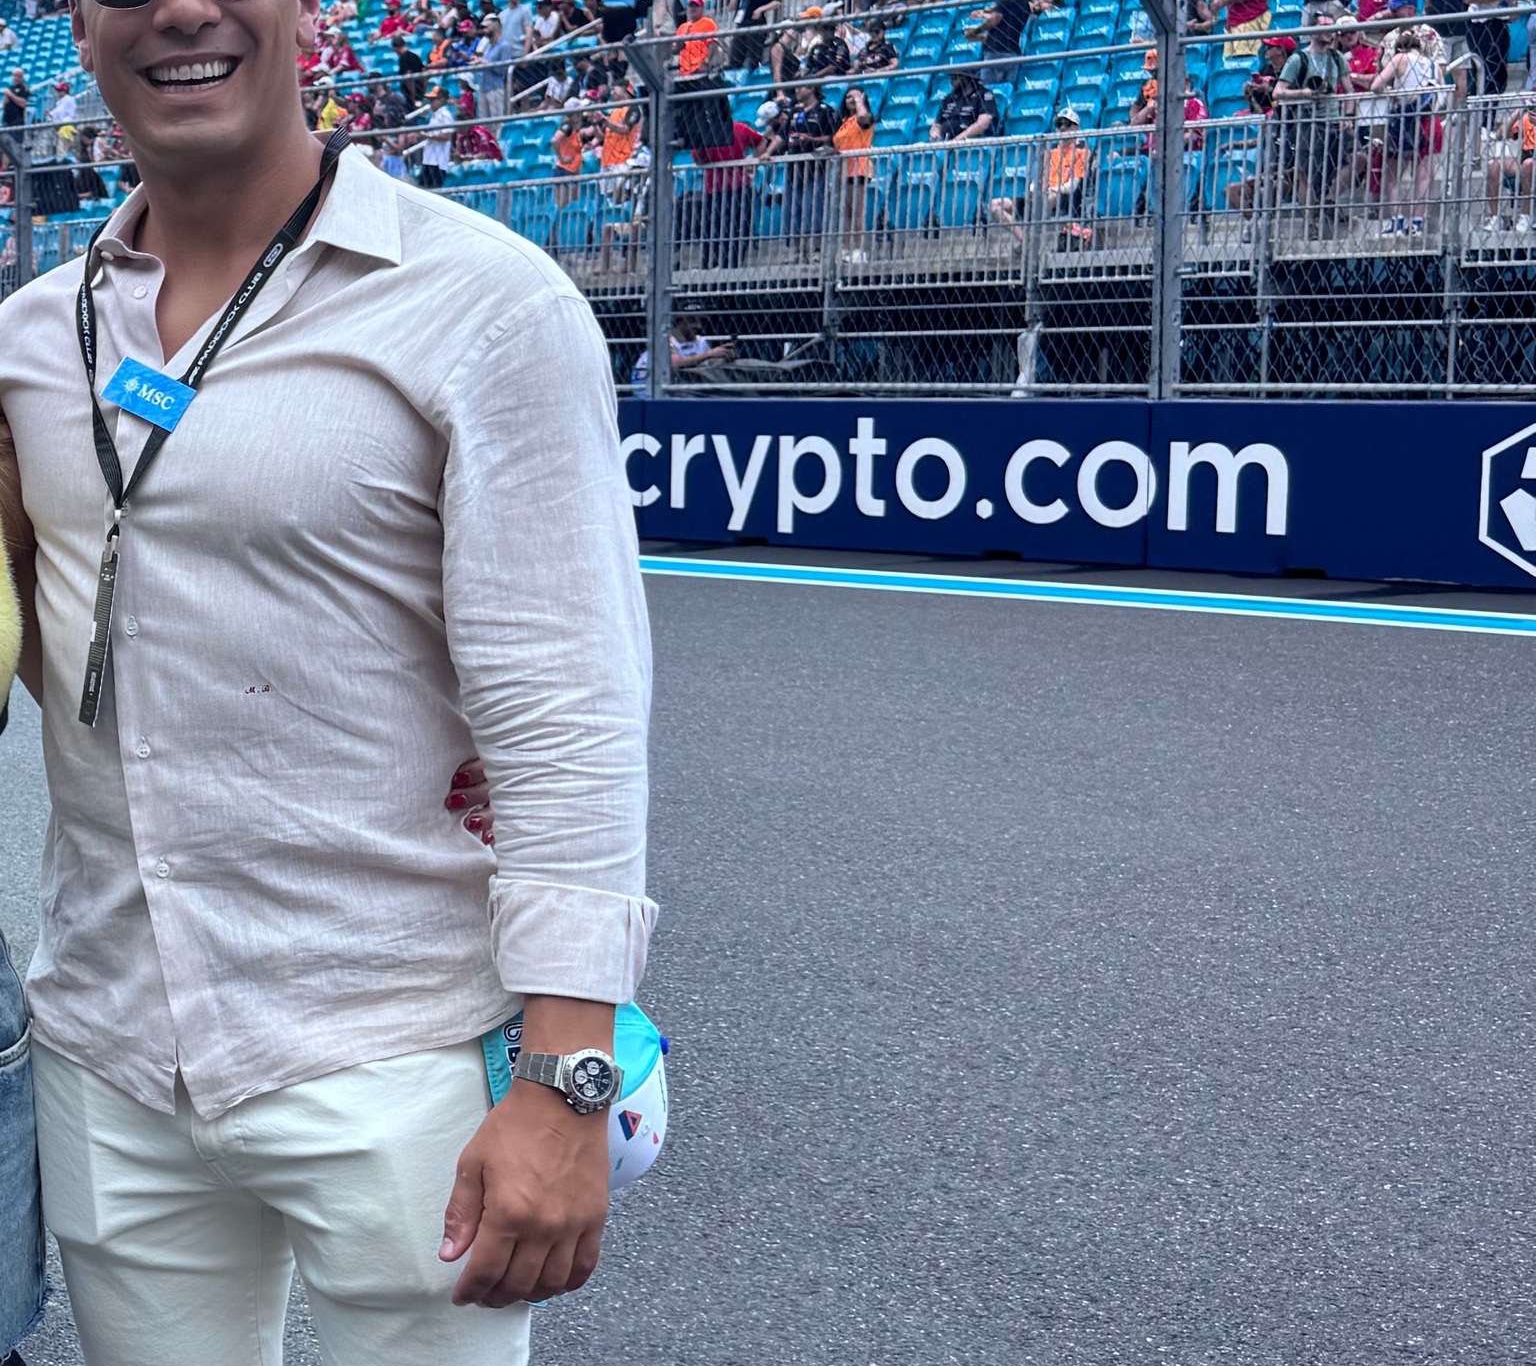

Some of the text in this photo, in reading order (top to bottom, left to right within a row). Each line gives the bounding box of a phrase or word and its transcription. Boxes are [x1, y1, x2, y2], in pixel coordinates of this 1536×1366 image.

[197, 305, 240, 366] PADDOCK
[239, 272, 263, 304] CLUB
[137, 384, 175, 410] MSC
[621, 417, 1289, 535] crypto.com
